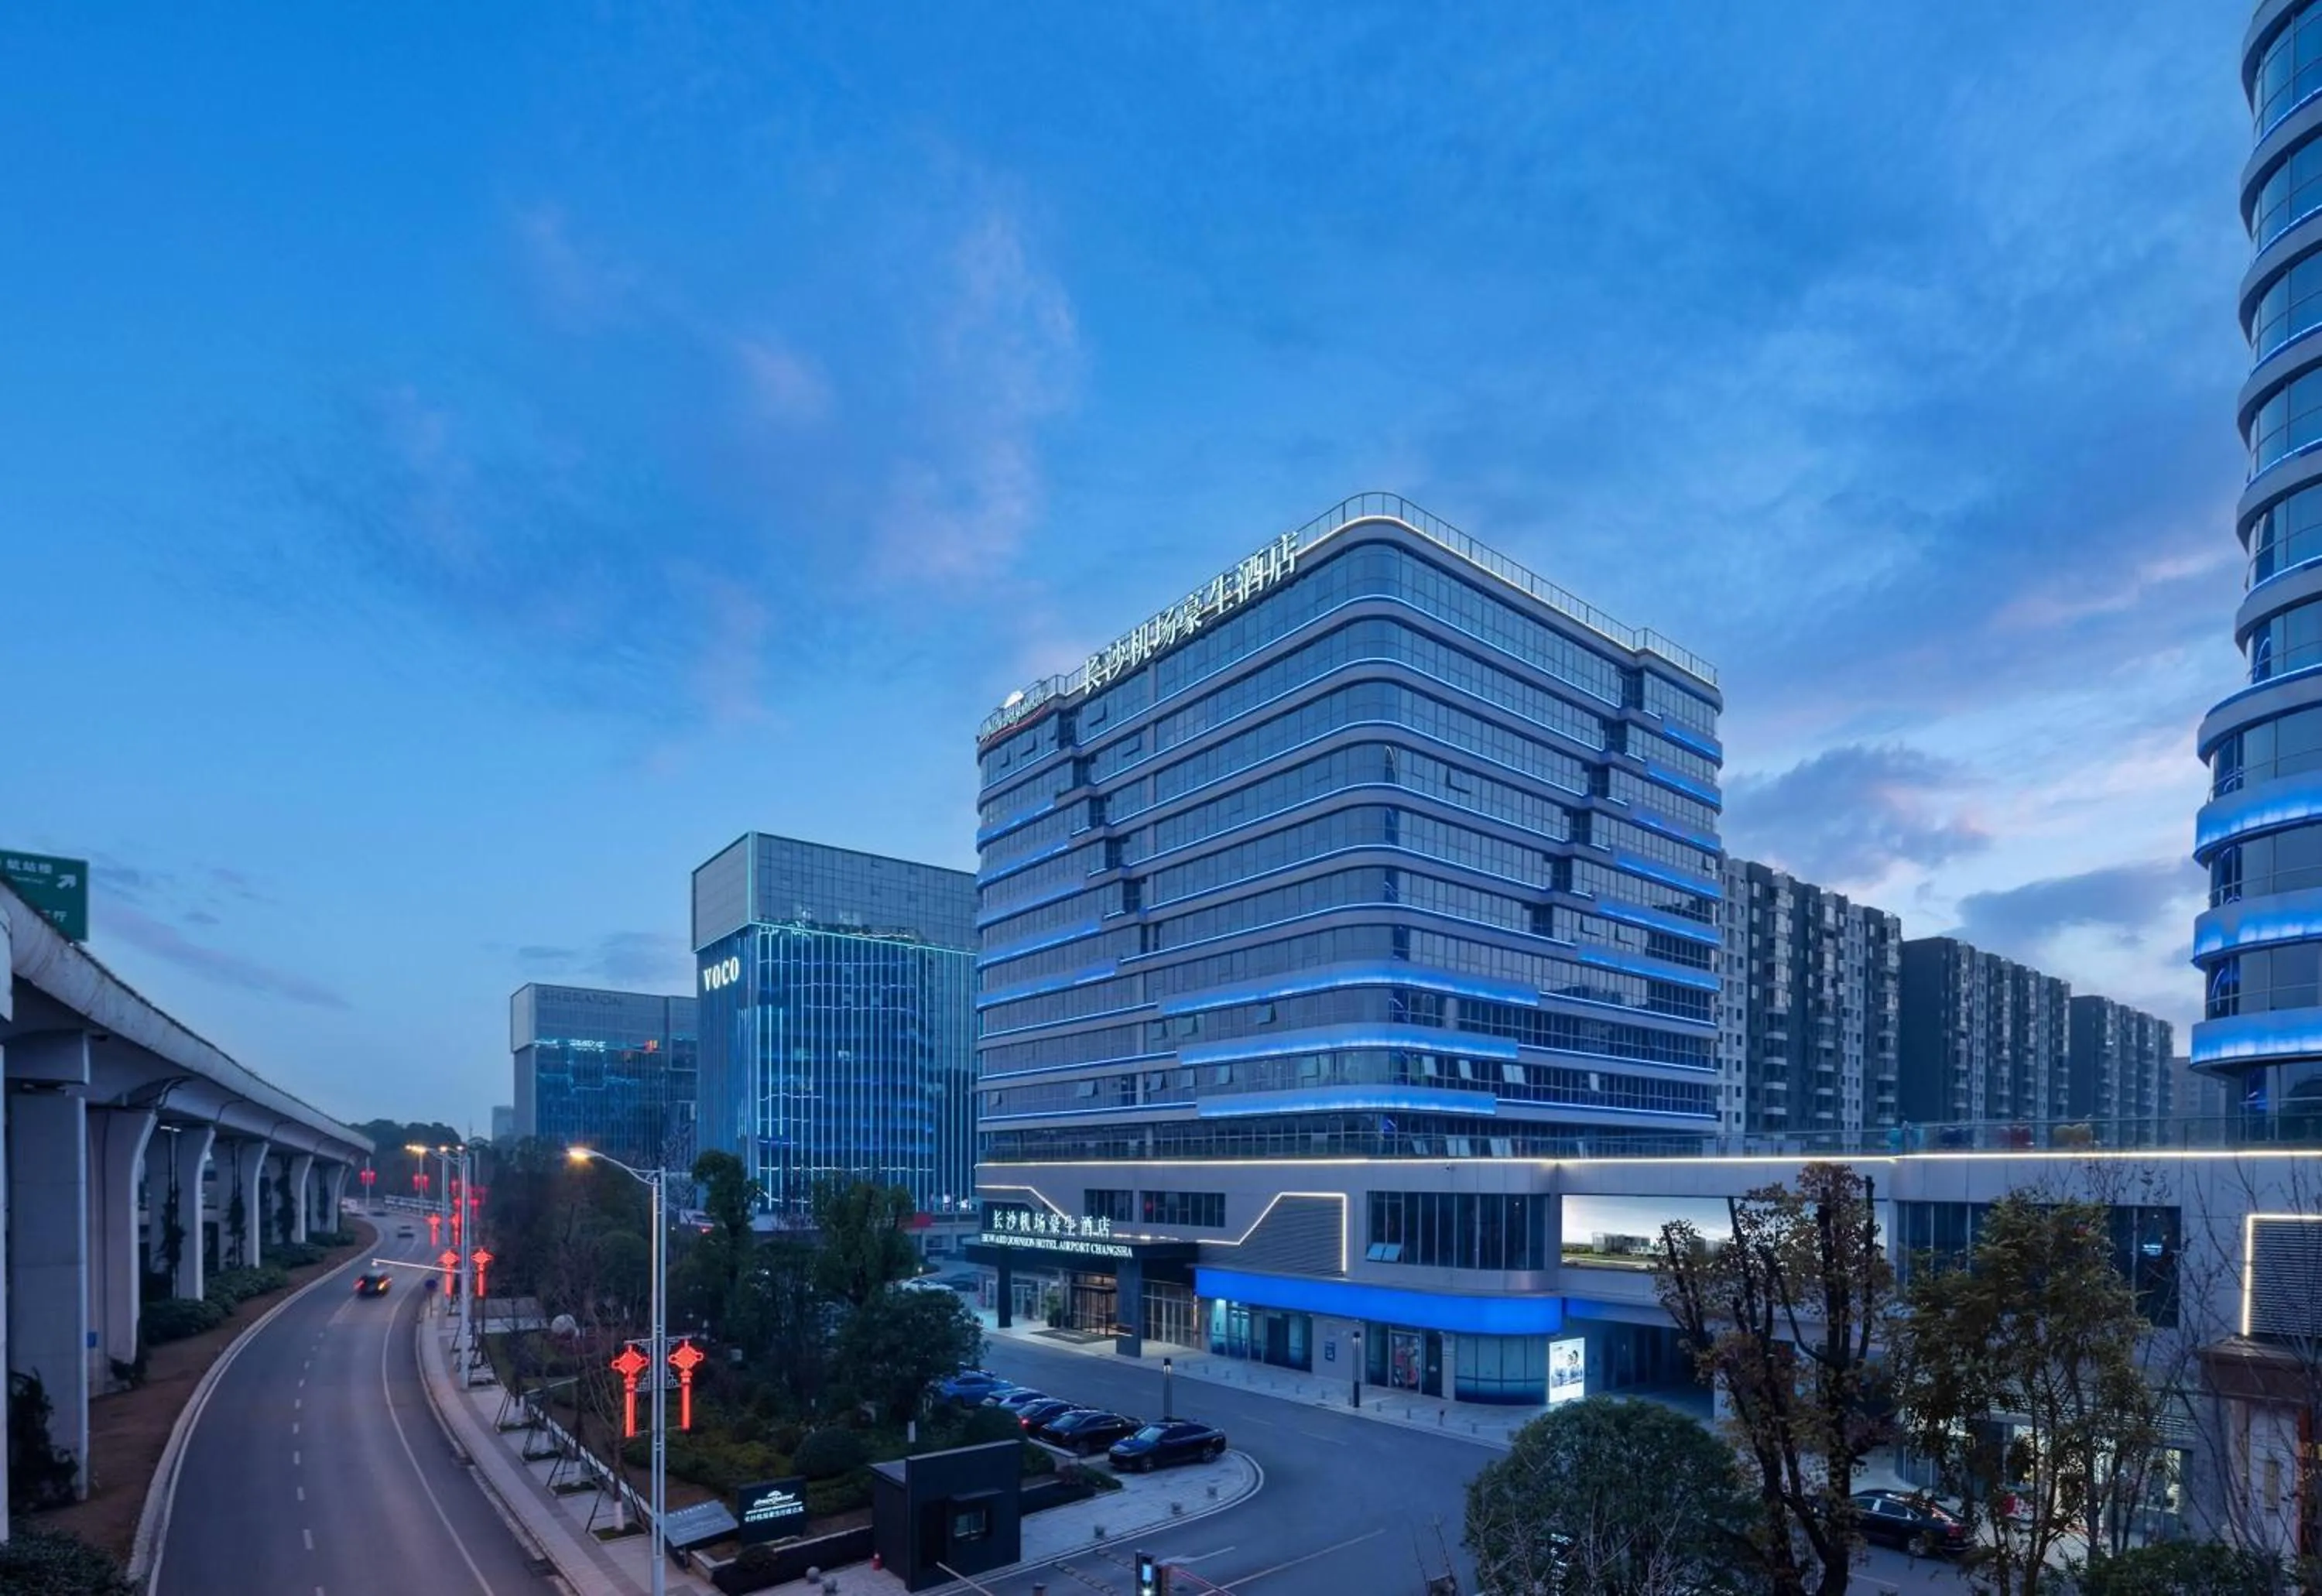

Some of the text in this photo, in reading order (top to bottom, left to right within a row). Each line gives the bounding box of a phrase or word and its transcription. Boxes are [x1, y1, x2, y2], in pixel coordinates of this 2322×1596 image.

[1084, 532, 1298, 694] 长沙机场豪生酒店
[993, 1210, 1111, 1238] 长沙机场豪生酒店
[1036, 1238, 1057, 1250] HOTEL
[1059, 1241, 1090, 1252] AIRPORT
[1091, 1243, 1132, 1258] CHANGSHA
